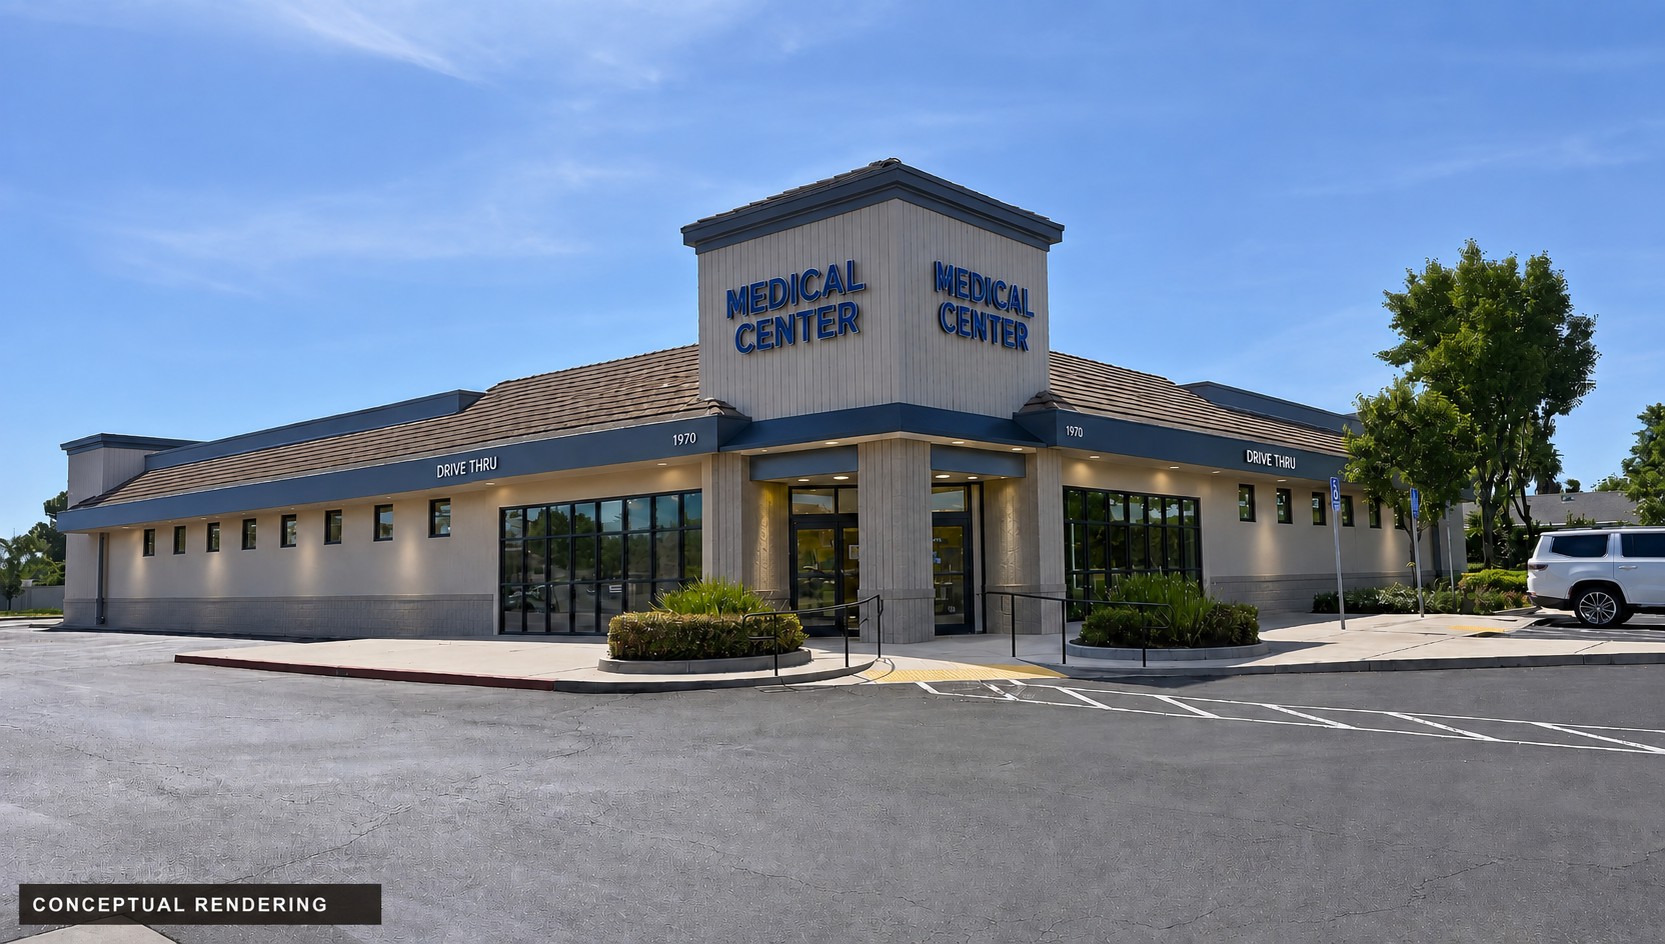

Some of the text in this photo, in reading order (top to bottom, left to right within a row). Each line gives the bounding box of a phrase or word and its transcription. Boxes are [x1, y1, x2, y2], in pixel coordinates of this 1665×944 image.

[726, 259, 866, 320] MEDICAL
[934, 260, 1035, 318] MEDICAL
[735, 301, 860, 354] CENTER
[938, 301, 1029, 352] CENTER
[672, 432, 697, 446] 1970
[1066, 425, 1084, 438] 1970
[436, 456, 498, 479] DRIVE THRU
[1246, 449, 1296, 470] DRIVE THRU
